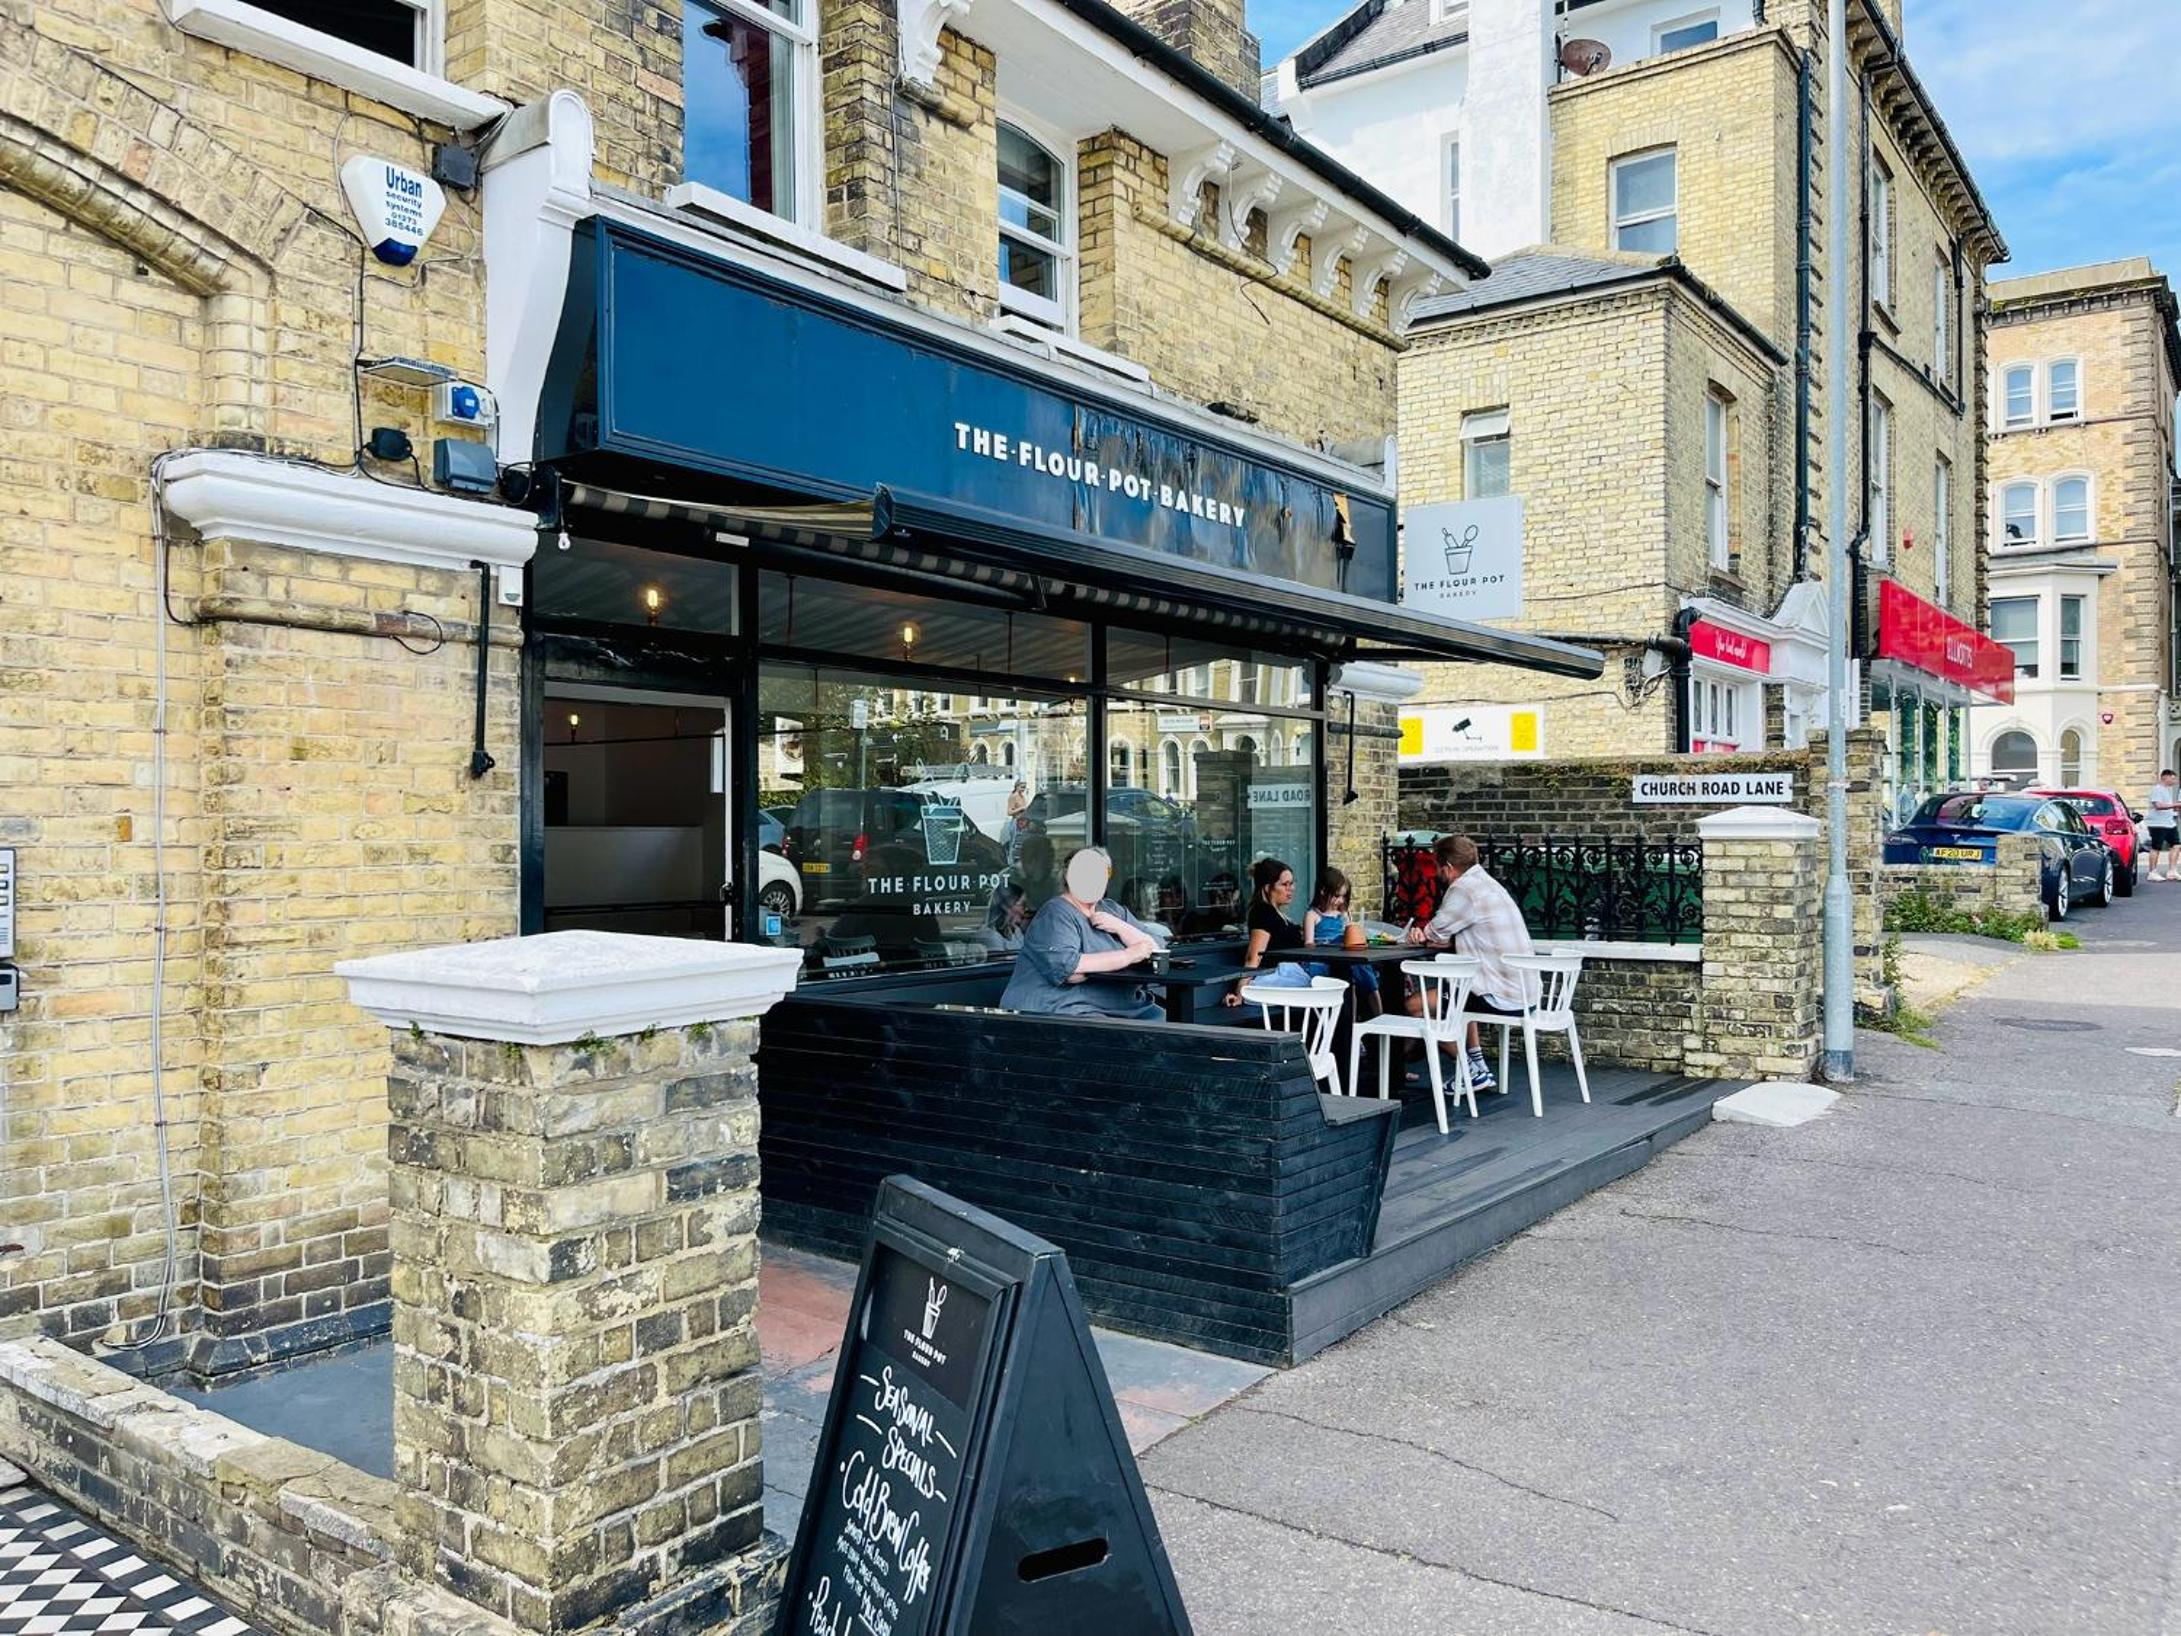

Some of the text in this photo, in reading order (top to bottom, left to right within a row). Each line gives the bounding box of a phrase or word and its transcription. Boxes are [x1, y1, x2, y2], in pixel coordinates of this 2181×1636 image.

[386, 165, 423, 198] Urban
[386, 191, 422, 209] security
[386, 201, 423, 218] systems
[955, 422, 1245, 528] THE FLOUR POT BAKERY
[1414, 574, 1505, 591] THE FLOUR POT
[1440, 590, 1477, 599] BAKERY
[1641, 781, 1785, 796] CHURCH ROAD LANE
[868, 873, 1011, 894] THE FLOUR POT
[912, 901, 971, 916] BAKERY
[904, 1329, 916, 1344] THE
[933, 1350, 947, 1366] POT
[874, 1365, 934, 1447] SEASONAL
[881, 1426, 936, 1499] SPECIALS
[842, 1450, 880, 1531] Cold
[899, 1510, 932, 1605] Coffee
